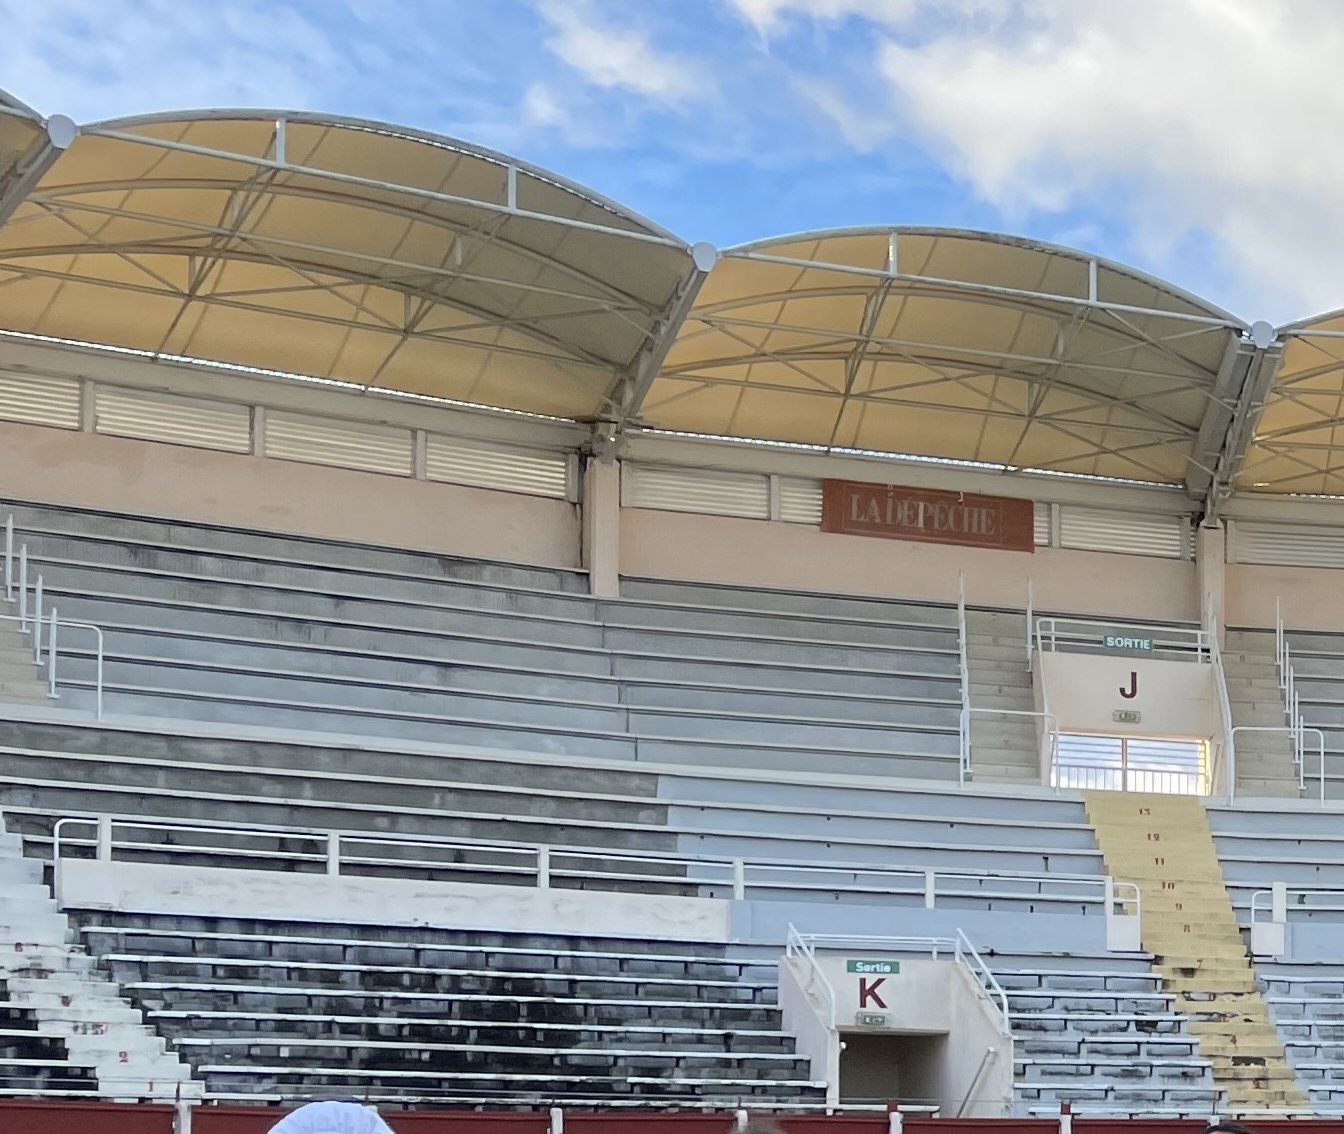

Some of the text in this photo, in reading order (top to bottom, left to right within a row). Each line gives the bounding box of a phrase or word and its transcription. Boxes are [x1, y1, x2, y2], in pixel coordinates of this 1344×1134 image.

[851, 494, 881, 523] LA
[1106, 636, 1150, 650] SORTIE
[1119, 671, 1137, 699] J
[856, 962, 891, 973] Sortie
[859, 978, 888, 1008] K
